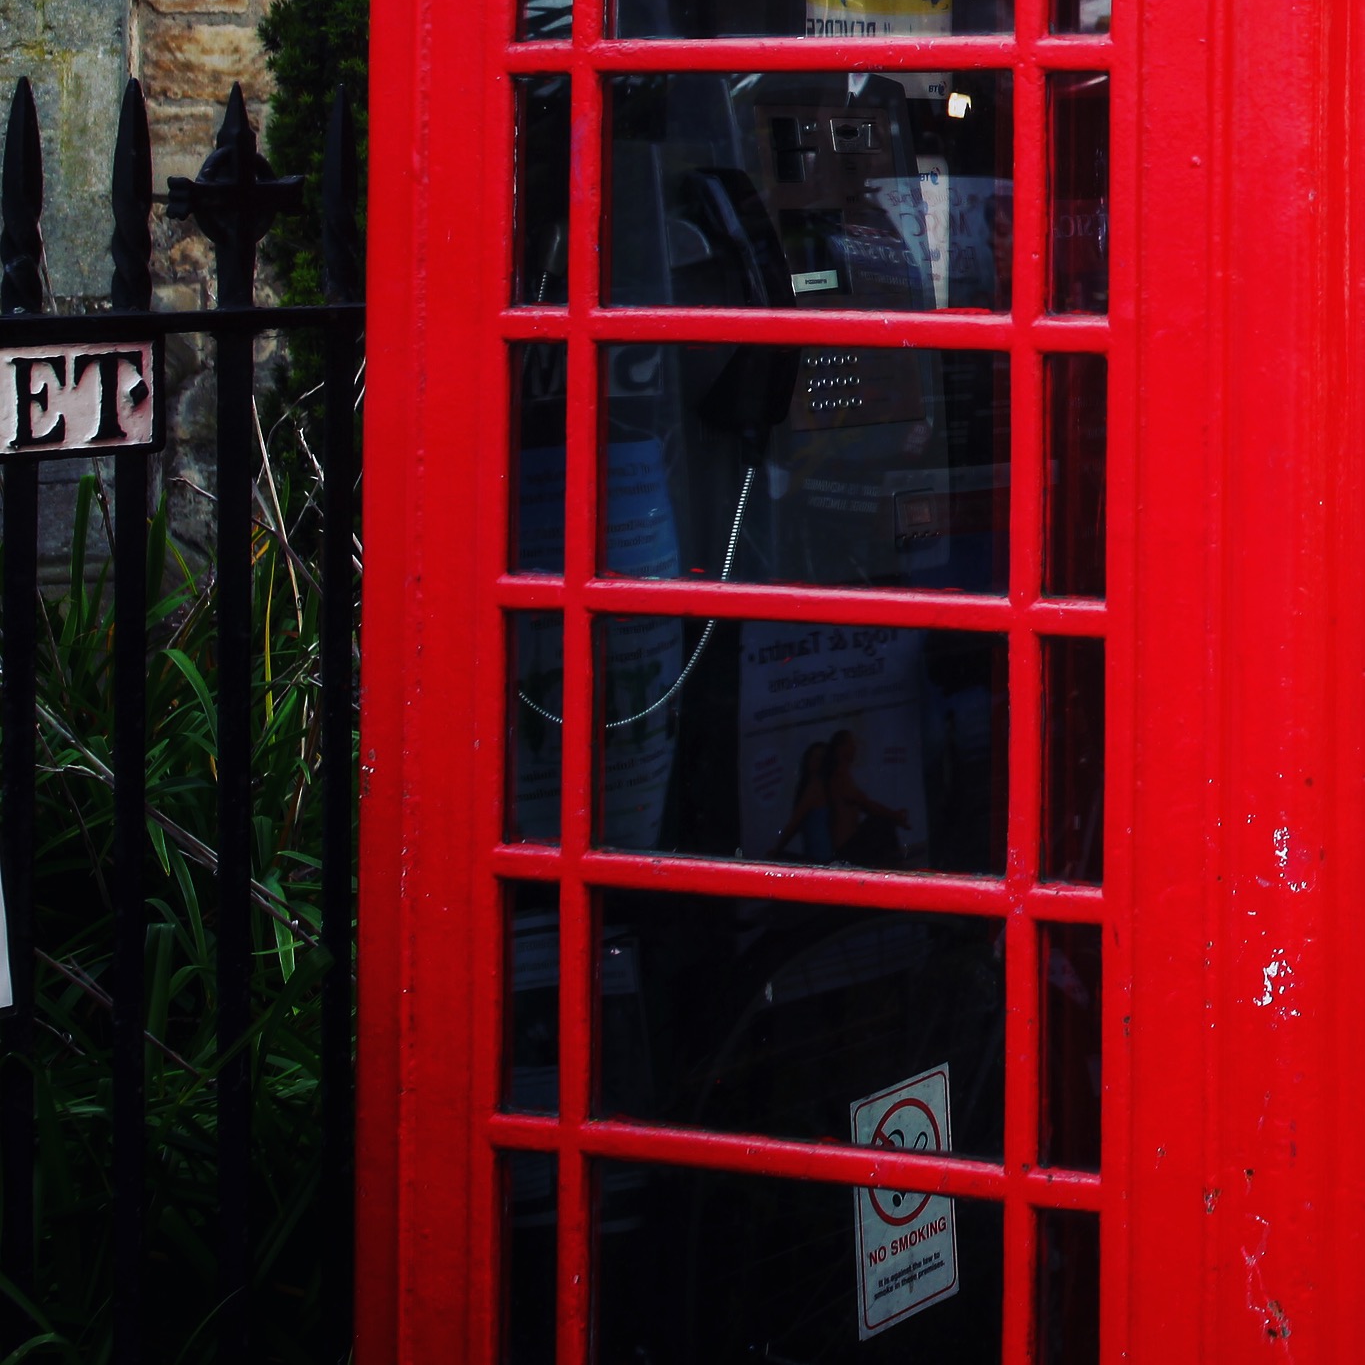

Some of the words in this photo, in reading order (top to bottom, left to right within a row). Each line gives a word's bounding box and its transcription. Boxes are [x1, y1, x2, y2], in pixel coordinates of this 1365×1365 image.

[869, 1246, 886, 1267] NO
[891, 1217, 947, 1255] SMOKING
[912, 1260, 922, 1271] the
[923, 1255, 933, 1266] law
[933, 1252, 940, 1260] to
